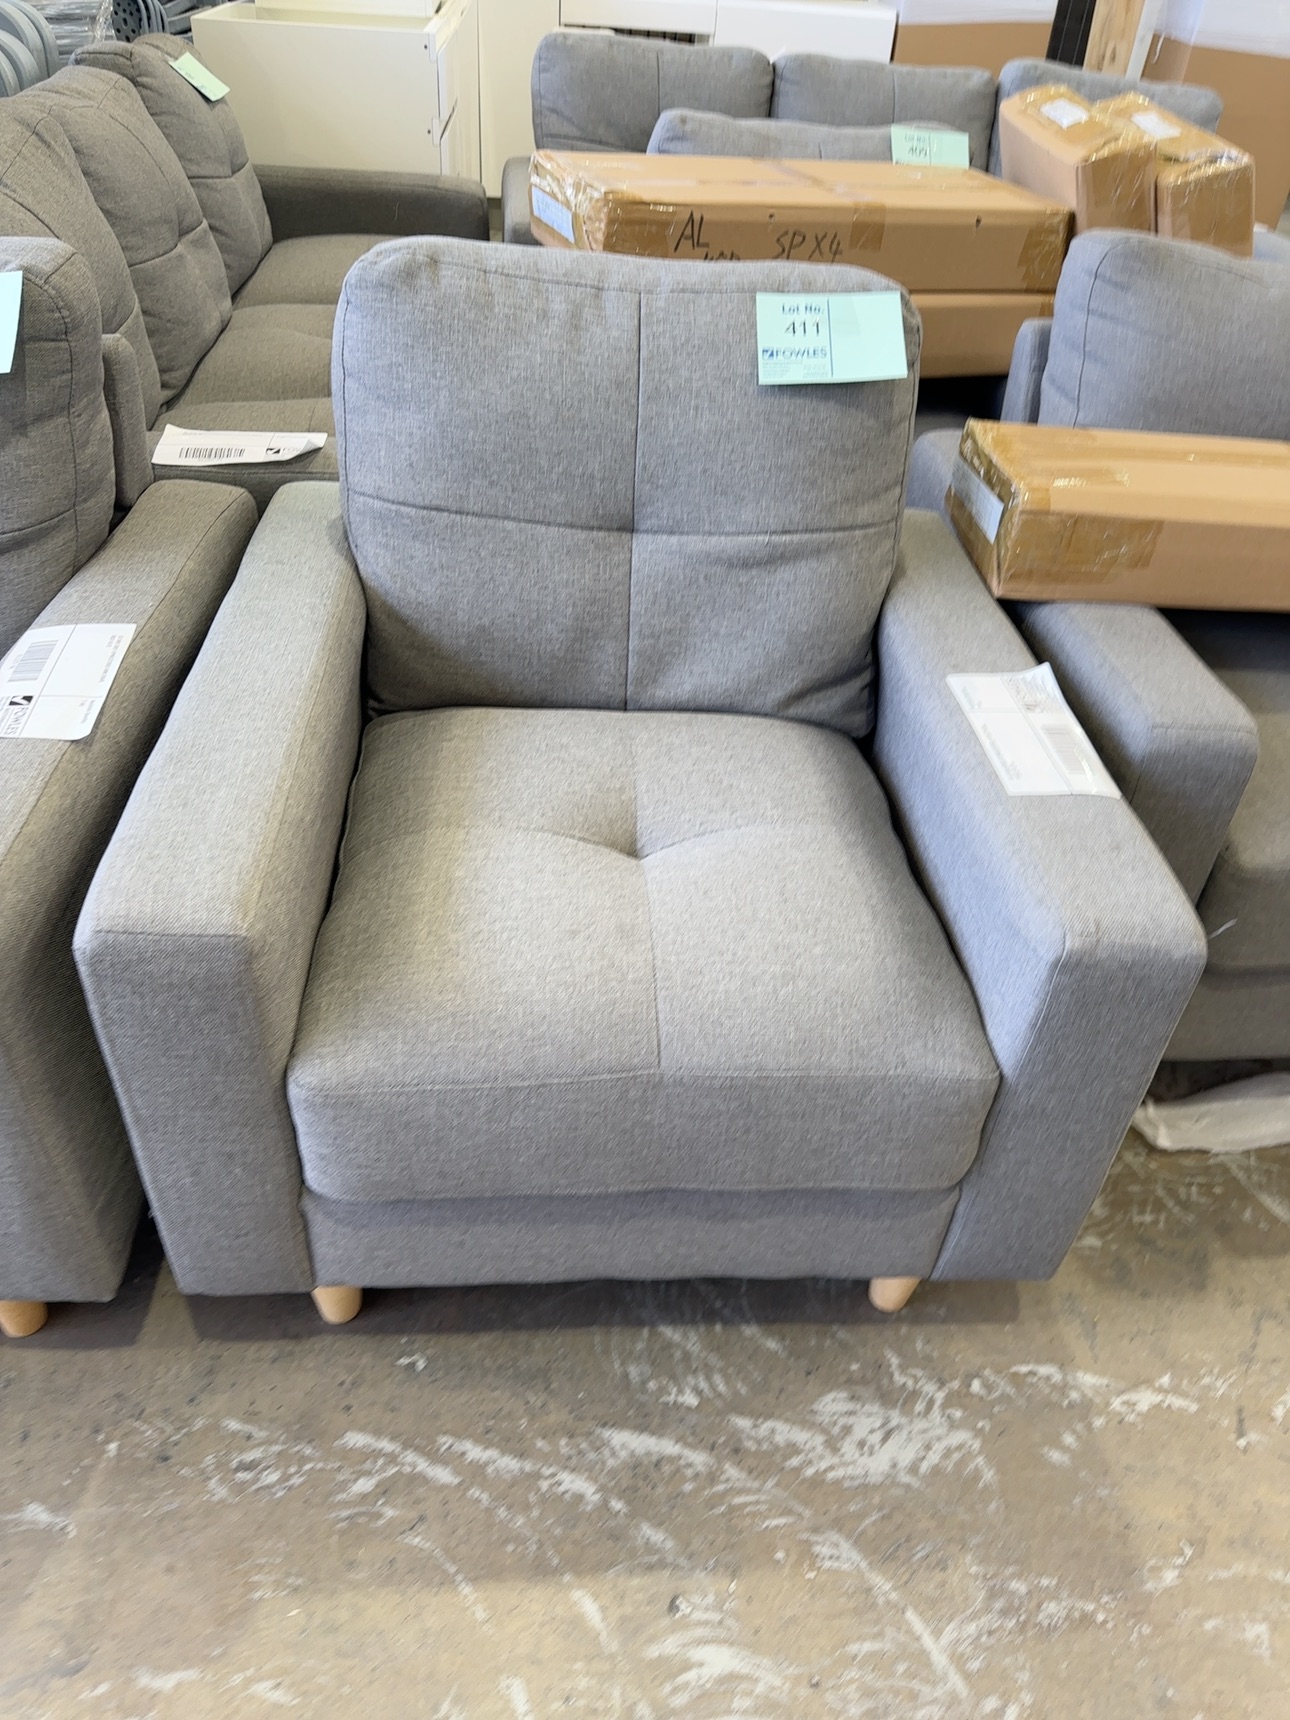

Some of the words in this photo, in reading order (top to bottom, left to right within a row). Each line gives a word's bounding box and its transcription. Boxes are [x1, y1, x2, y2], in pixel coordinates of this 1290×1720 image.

[674, 210, 710, 253] AL
[782, 303, 800, 315] Lot
[784, 320, 820, 337] 411
[775, 347, 828, 360] FOWLES
